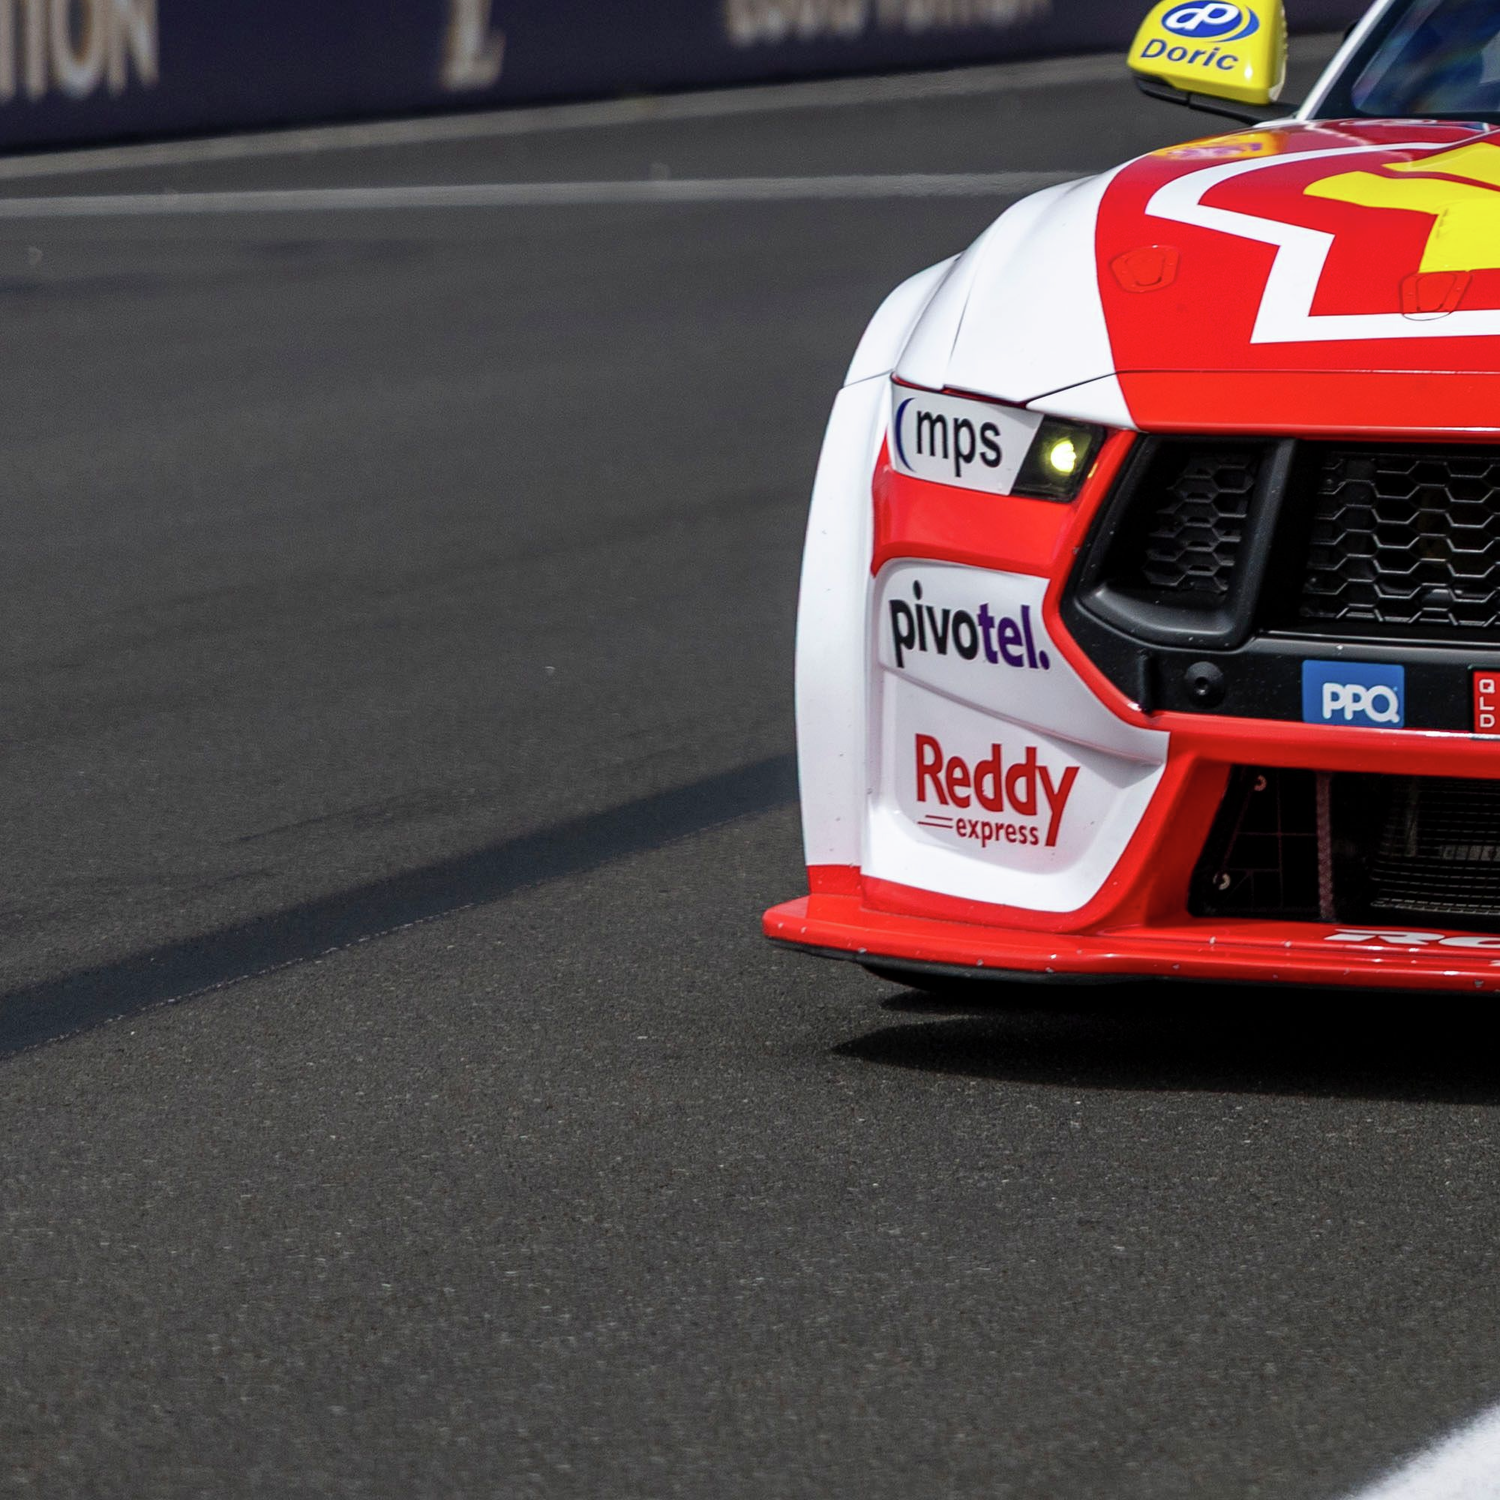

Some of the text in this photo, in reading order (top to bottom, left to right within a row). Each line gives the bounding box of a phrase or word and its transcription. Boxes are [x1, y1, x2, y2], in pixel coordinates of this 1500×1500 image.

[1140, 38, 1239, 71] Doric
[915, 406, 1003, 477] mps
[889, 580, 1051, 671] pivotel.
[1322, 682, 1400, 724] PPQ
[915, 734, 1080, 848] Reddy
[955, 815, 1039, 848] express
